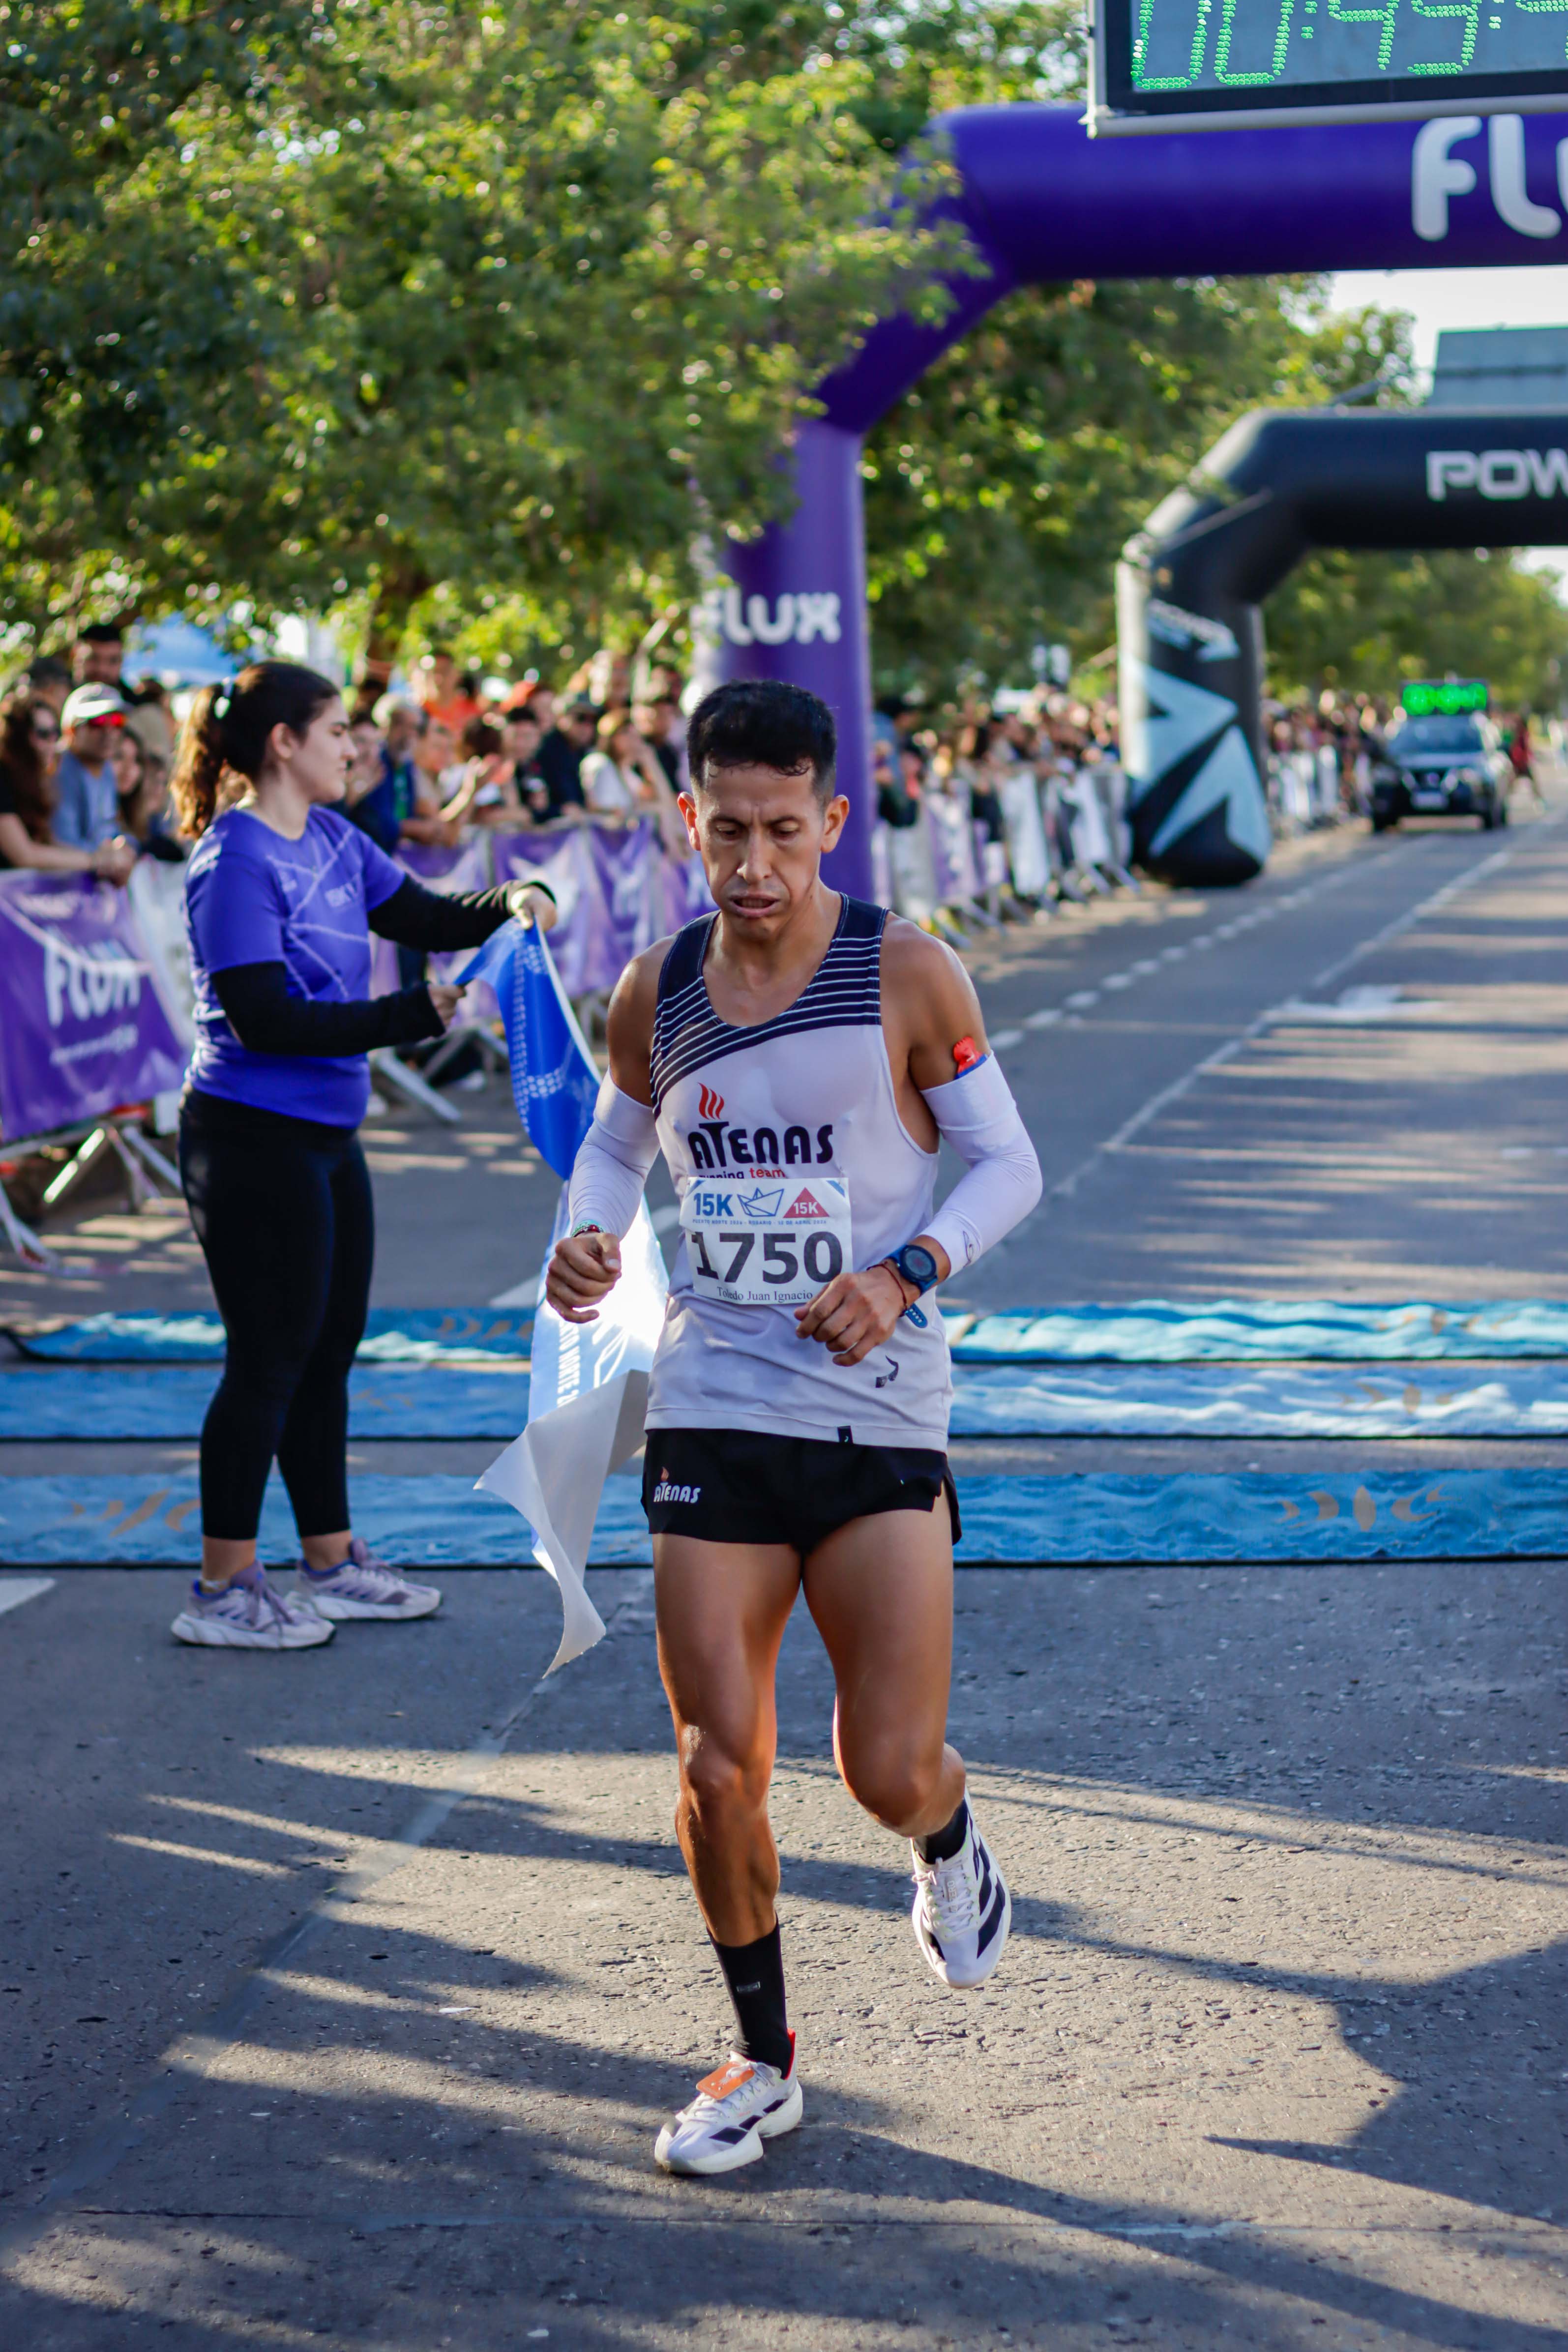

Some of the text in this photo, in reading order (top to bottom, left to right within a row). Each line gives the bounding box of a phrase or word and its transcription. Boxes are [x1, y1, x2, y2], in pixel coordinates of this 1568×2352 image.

[688, 1121, 833, 1169] ATENAS
[699, 1168, 786, 1179] ning team
[694, 1193, 734, 1216] 15K
[793, 1202, 819, 1214] 15K
[691, 1231, 843, 1284] 1750
[717, 1287, 813, 1303] Toledo Juan Ignacio
[653, 1482, 701, 1504] ATENAS
